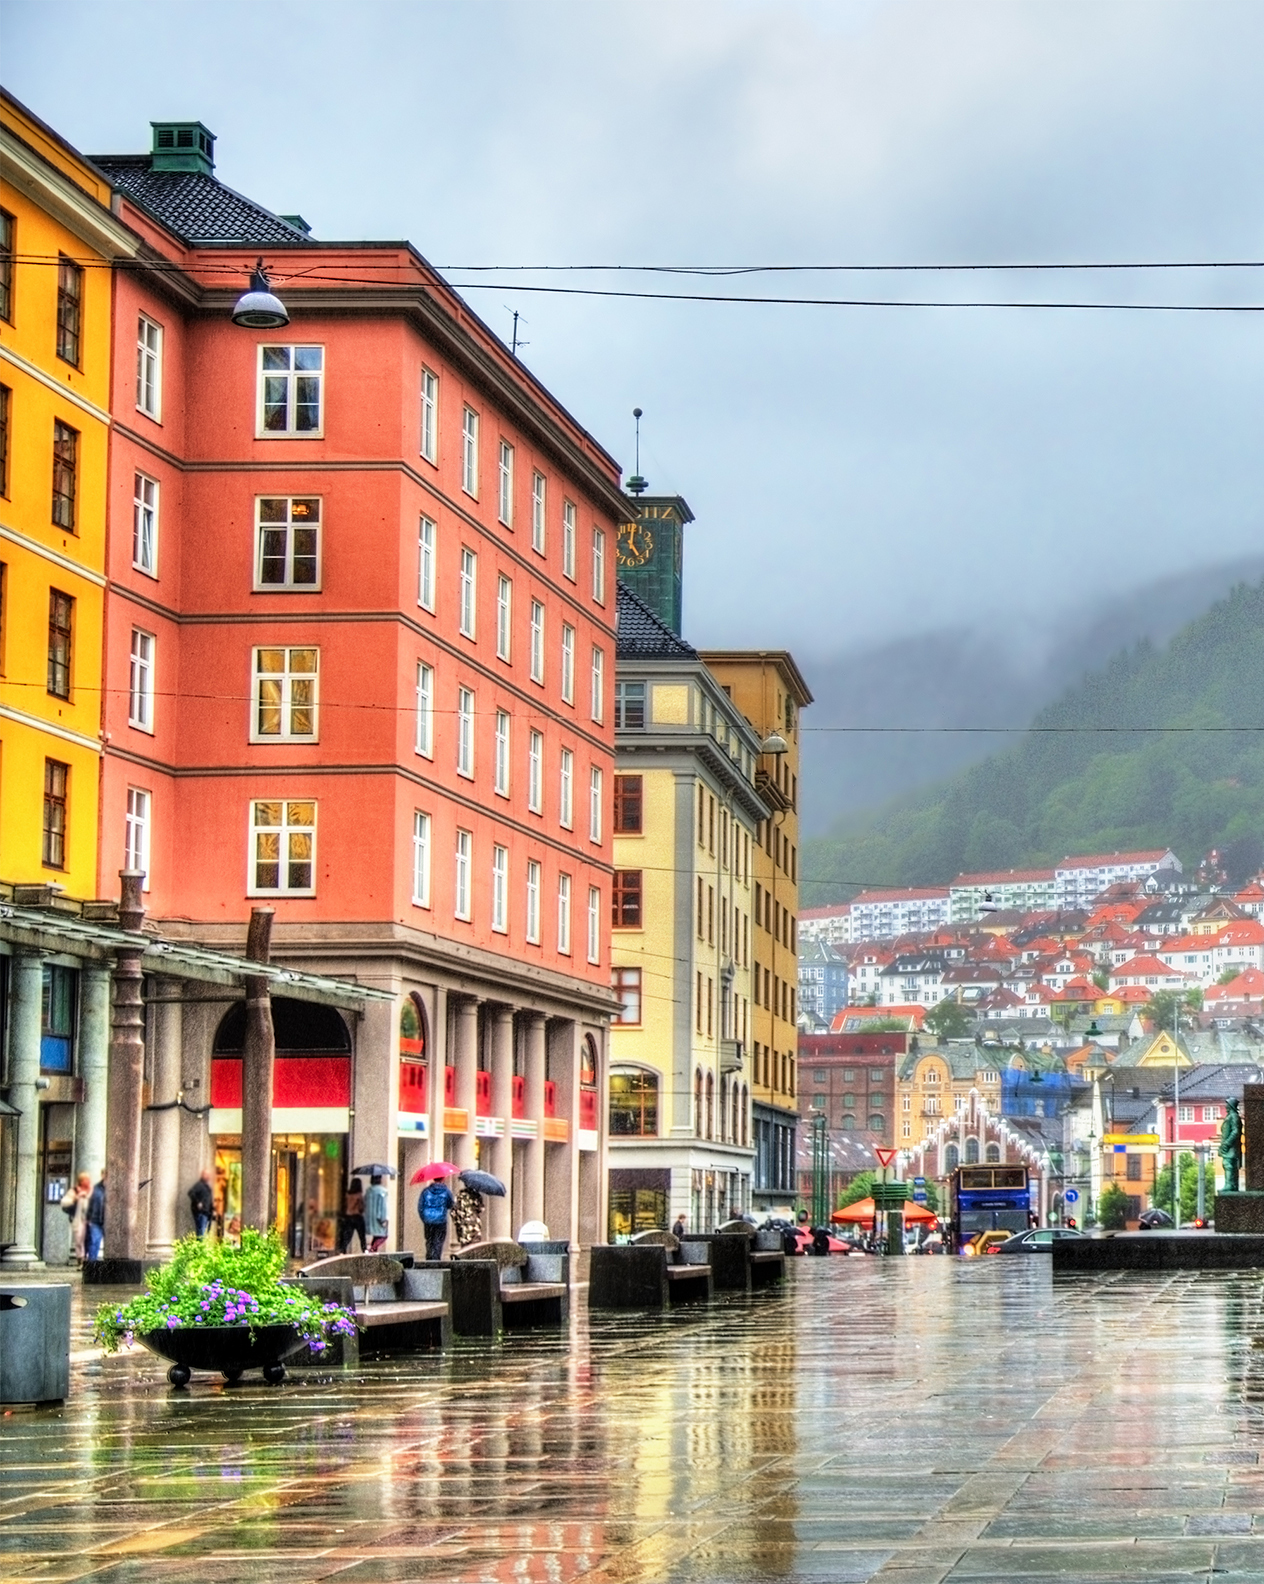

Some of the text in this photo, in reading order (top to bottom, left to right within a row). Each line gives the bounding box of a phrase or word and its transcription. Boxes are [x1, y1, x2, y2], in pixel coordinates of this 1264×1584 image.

[643, 531, 652, 541] 2
[645, 540, 653, 550] 3
[627, 557, 635, 567] 6
[636, 555, 645, 565] 5
